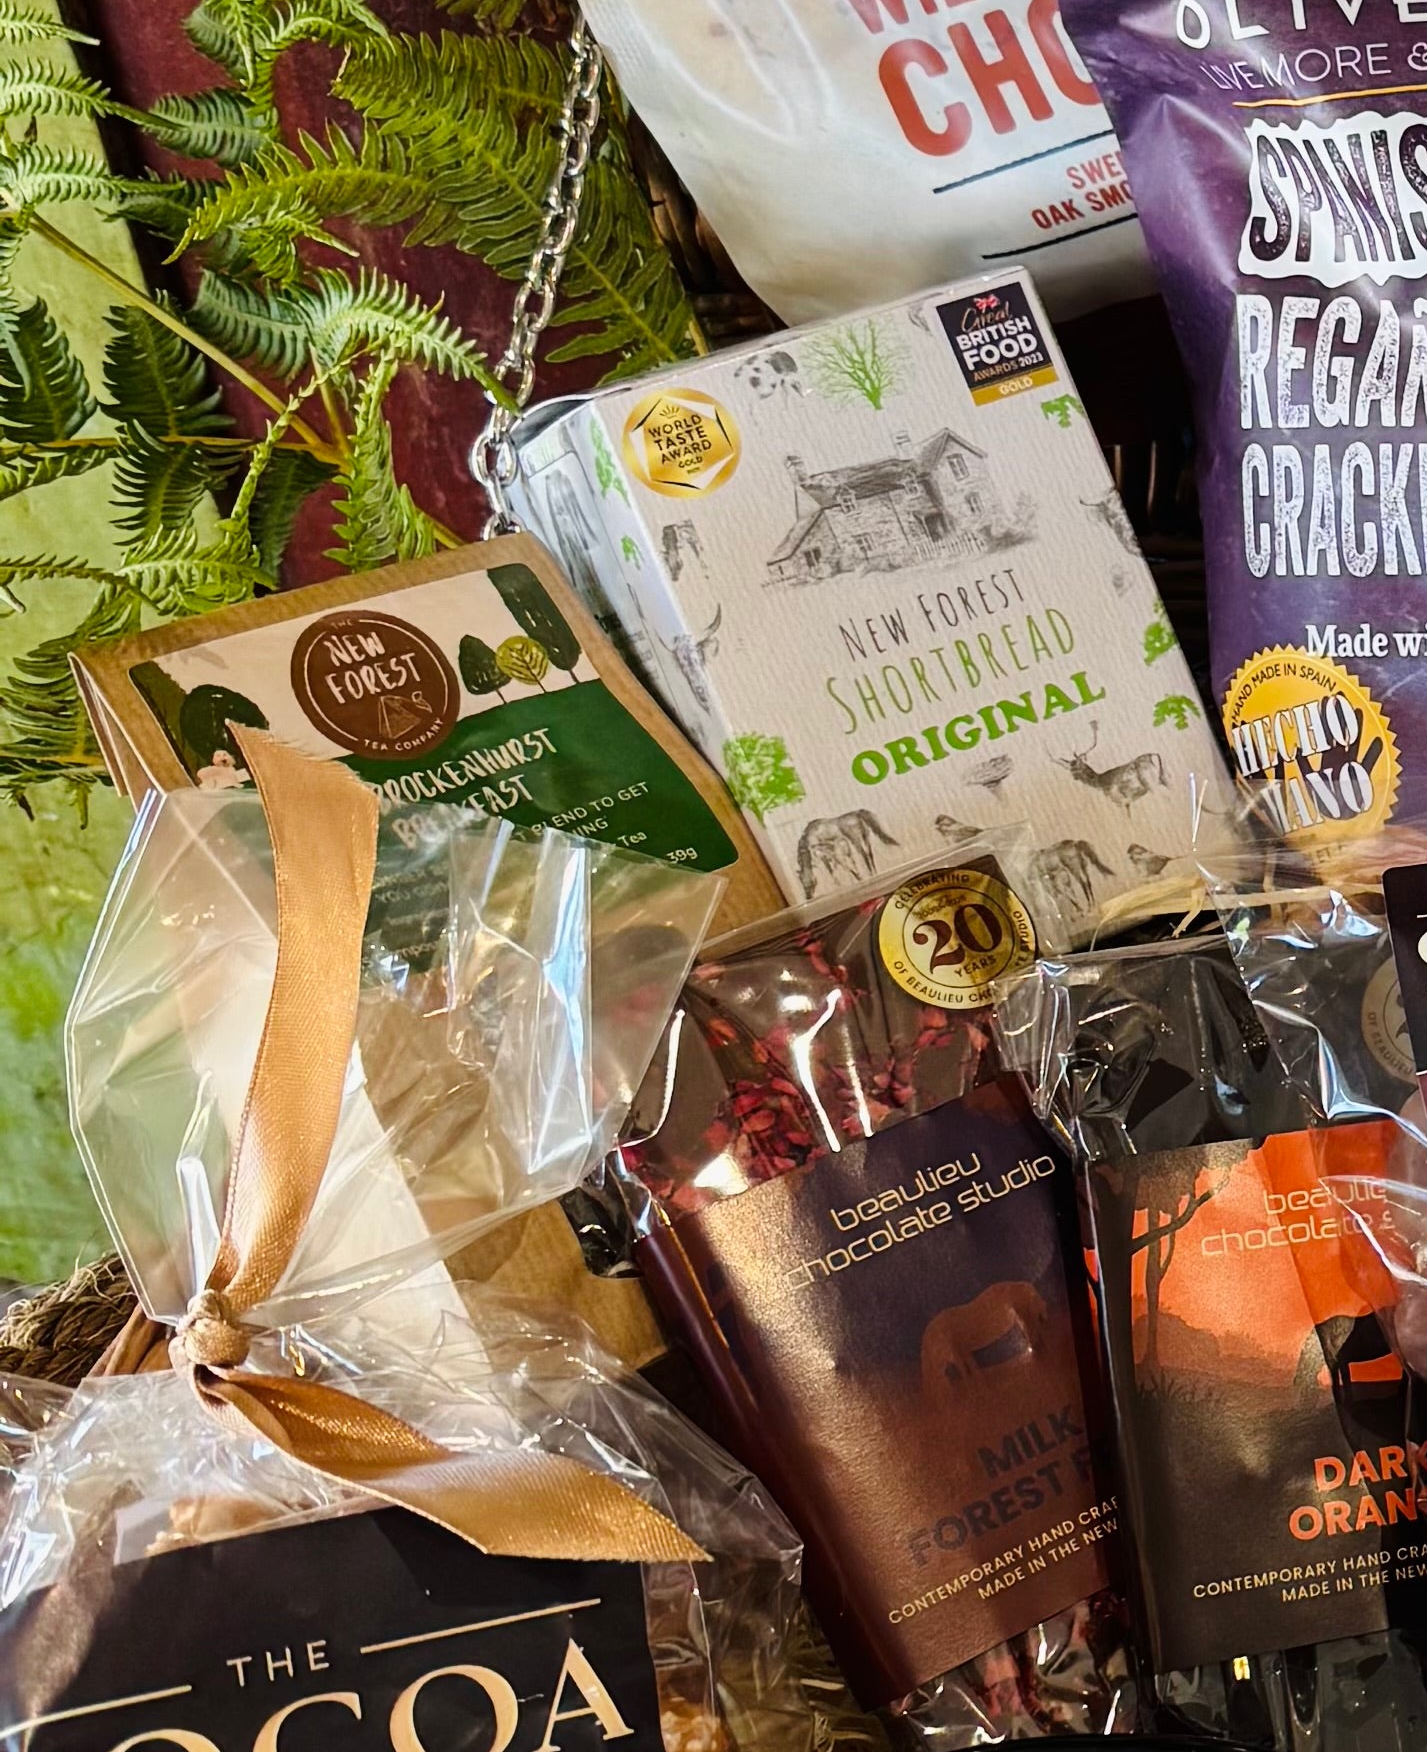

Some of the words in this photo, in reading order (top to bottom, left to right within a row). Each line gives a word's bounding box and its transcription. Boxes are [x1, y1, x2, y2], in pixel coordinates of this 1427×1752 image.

[324, 632, 385, 664] NEW
[838, 616, 911, 662] NEW
[917, 568, 1027, 639] FOREST
[1305, 623, 1388, 658] Made
[324, 653, 421, 704] FOREST
[826, 607, 1077, 735] SHORTBREAD
[850, 671, 1107, 787] ORIGINAL
[666, 847, 699, 865] 39g
[911, 902, 1002, 985] 20
[785, 1202, 952, 1289] chocolate
[957, 1152, 1057, 1216] studio
[829, 1151, 982, 1232] beaulieu
[226, 1640, 331, 1687] THE
